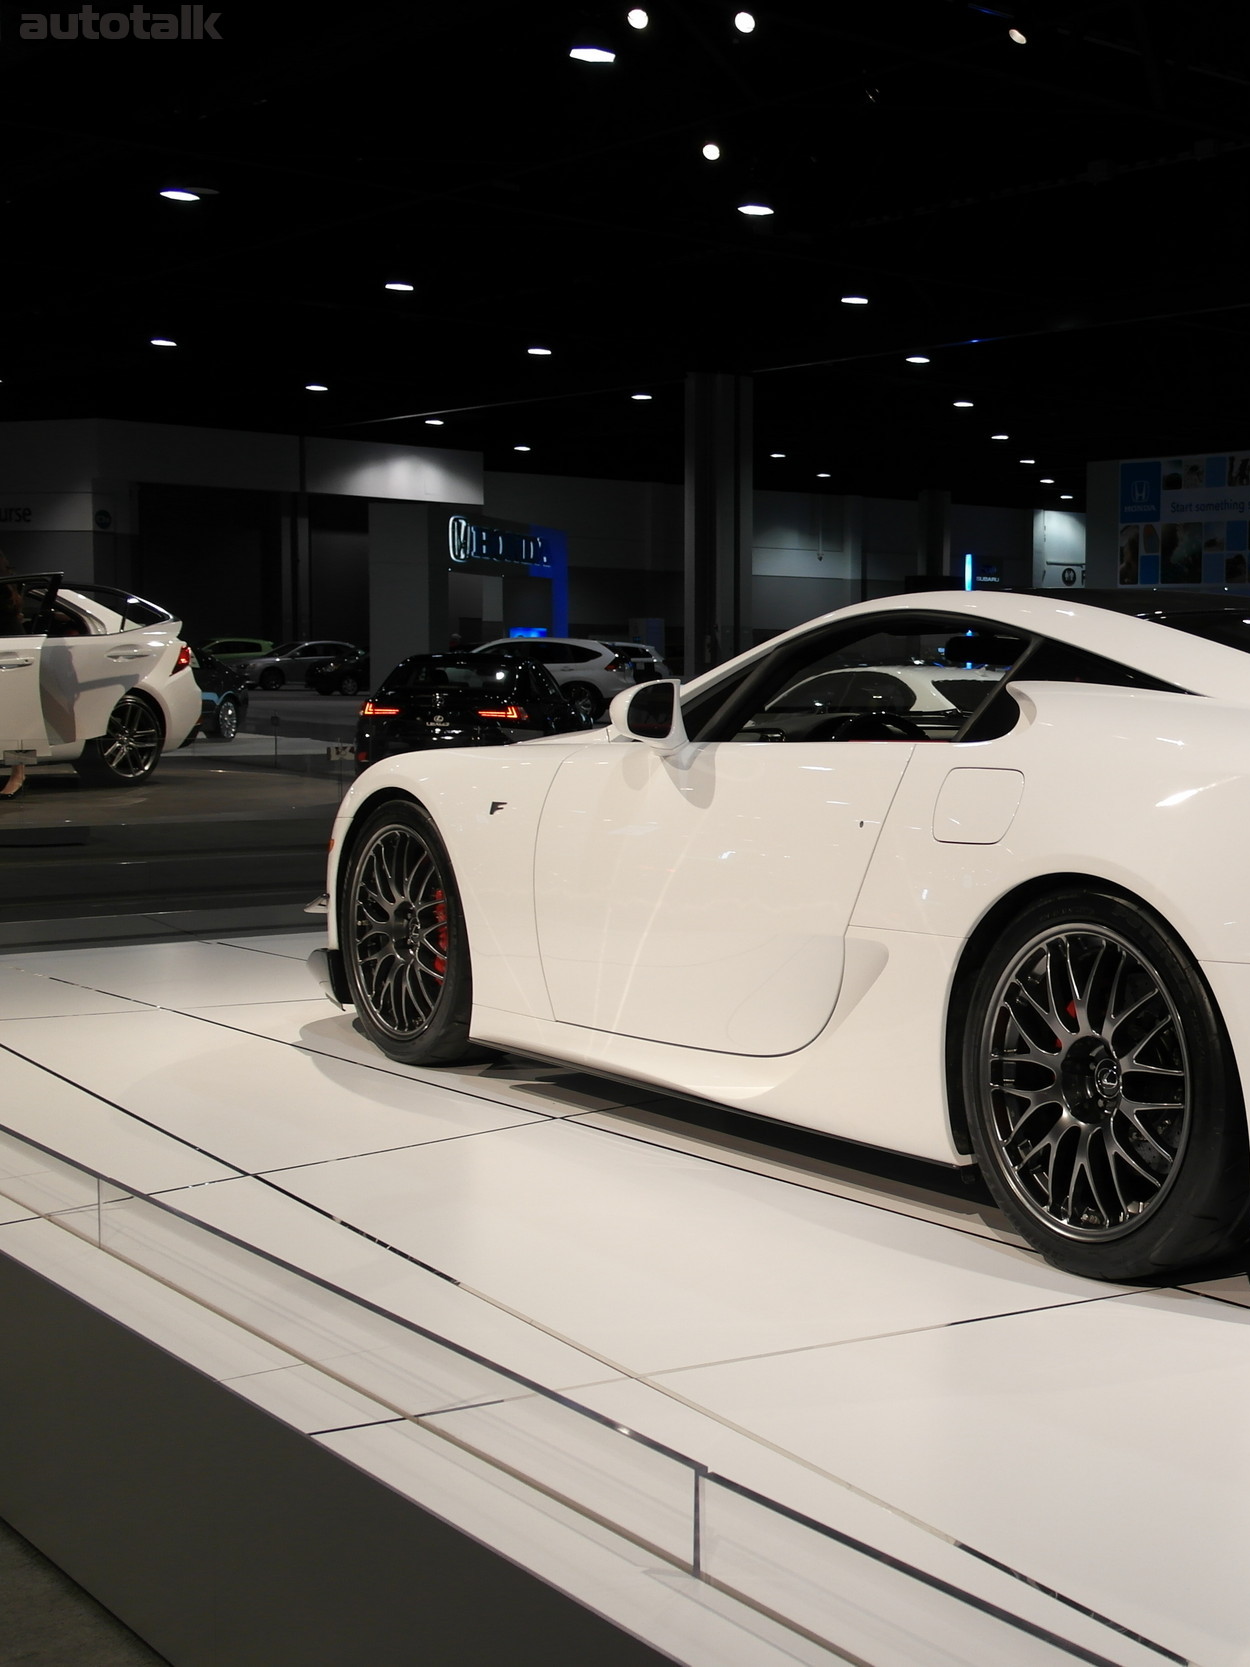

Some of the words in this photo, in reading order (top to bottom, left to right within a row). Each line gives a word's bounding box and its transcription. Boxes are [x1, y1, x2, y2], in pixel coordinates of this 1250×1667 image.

[1123, 504, 1156, 513] HONDA
[1170, 501, 1193, 513] Start
[1194, 499, 1245, 514] something
[976, 575, 1000, 583] SUBARU
